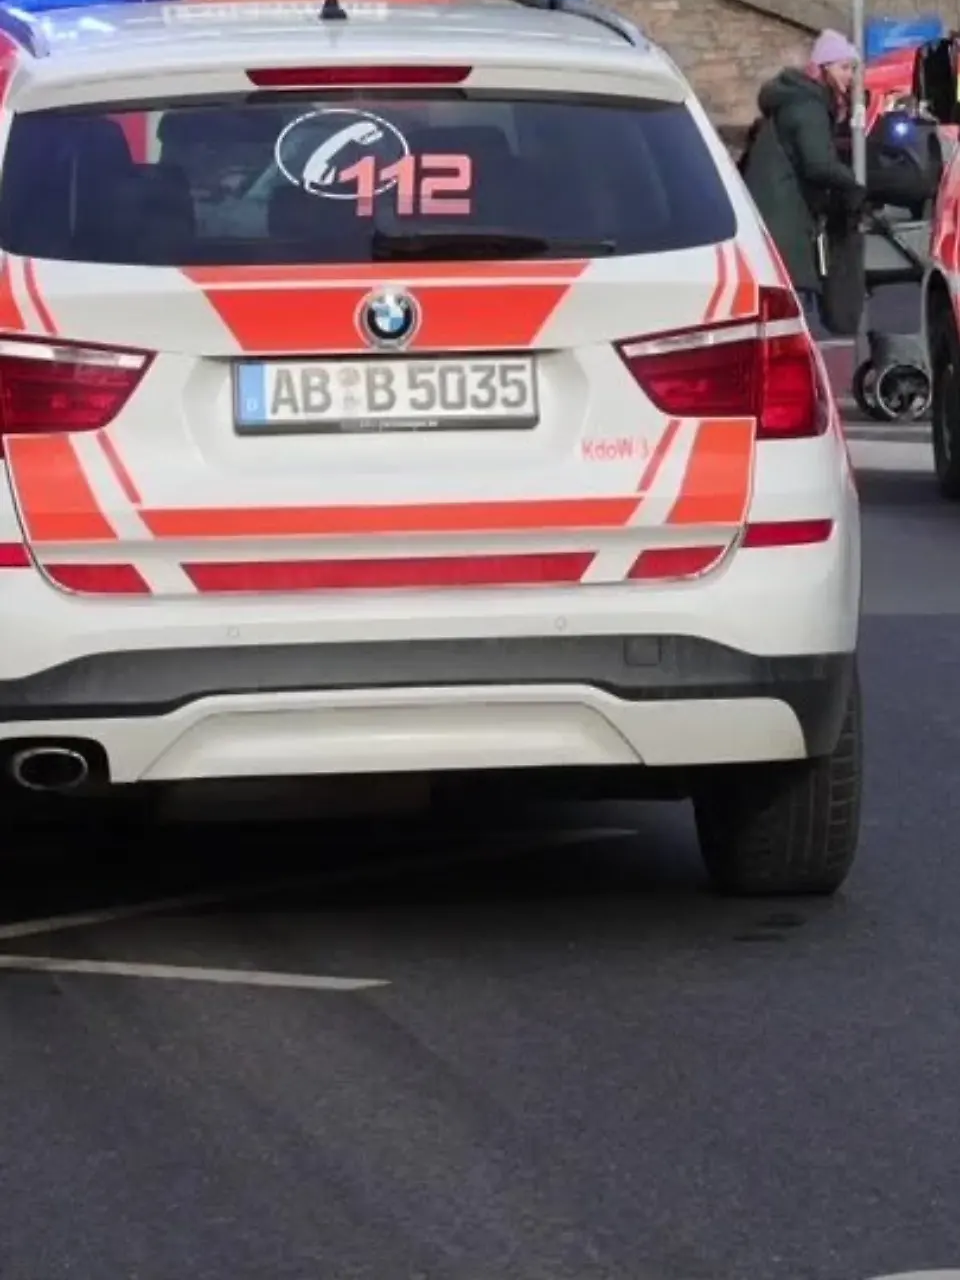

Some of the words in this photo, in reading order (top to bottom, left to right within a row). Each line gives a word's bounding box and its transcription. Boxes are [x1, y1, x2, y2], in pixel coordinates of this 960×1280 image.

[339, 154, 472, 216] 112
[271, 368, 332, 415] AB
[366, 368, 396, 412] B
[407, 365, 528, 410] 5035
